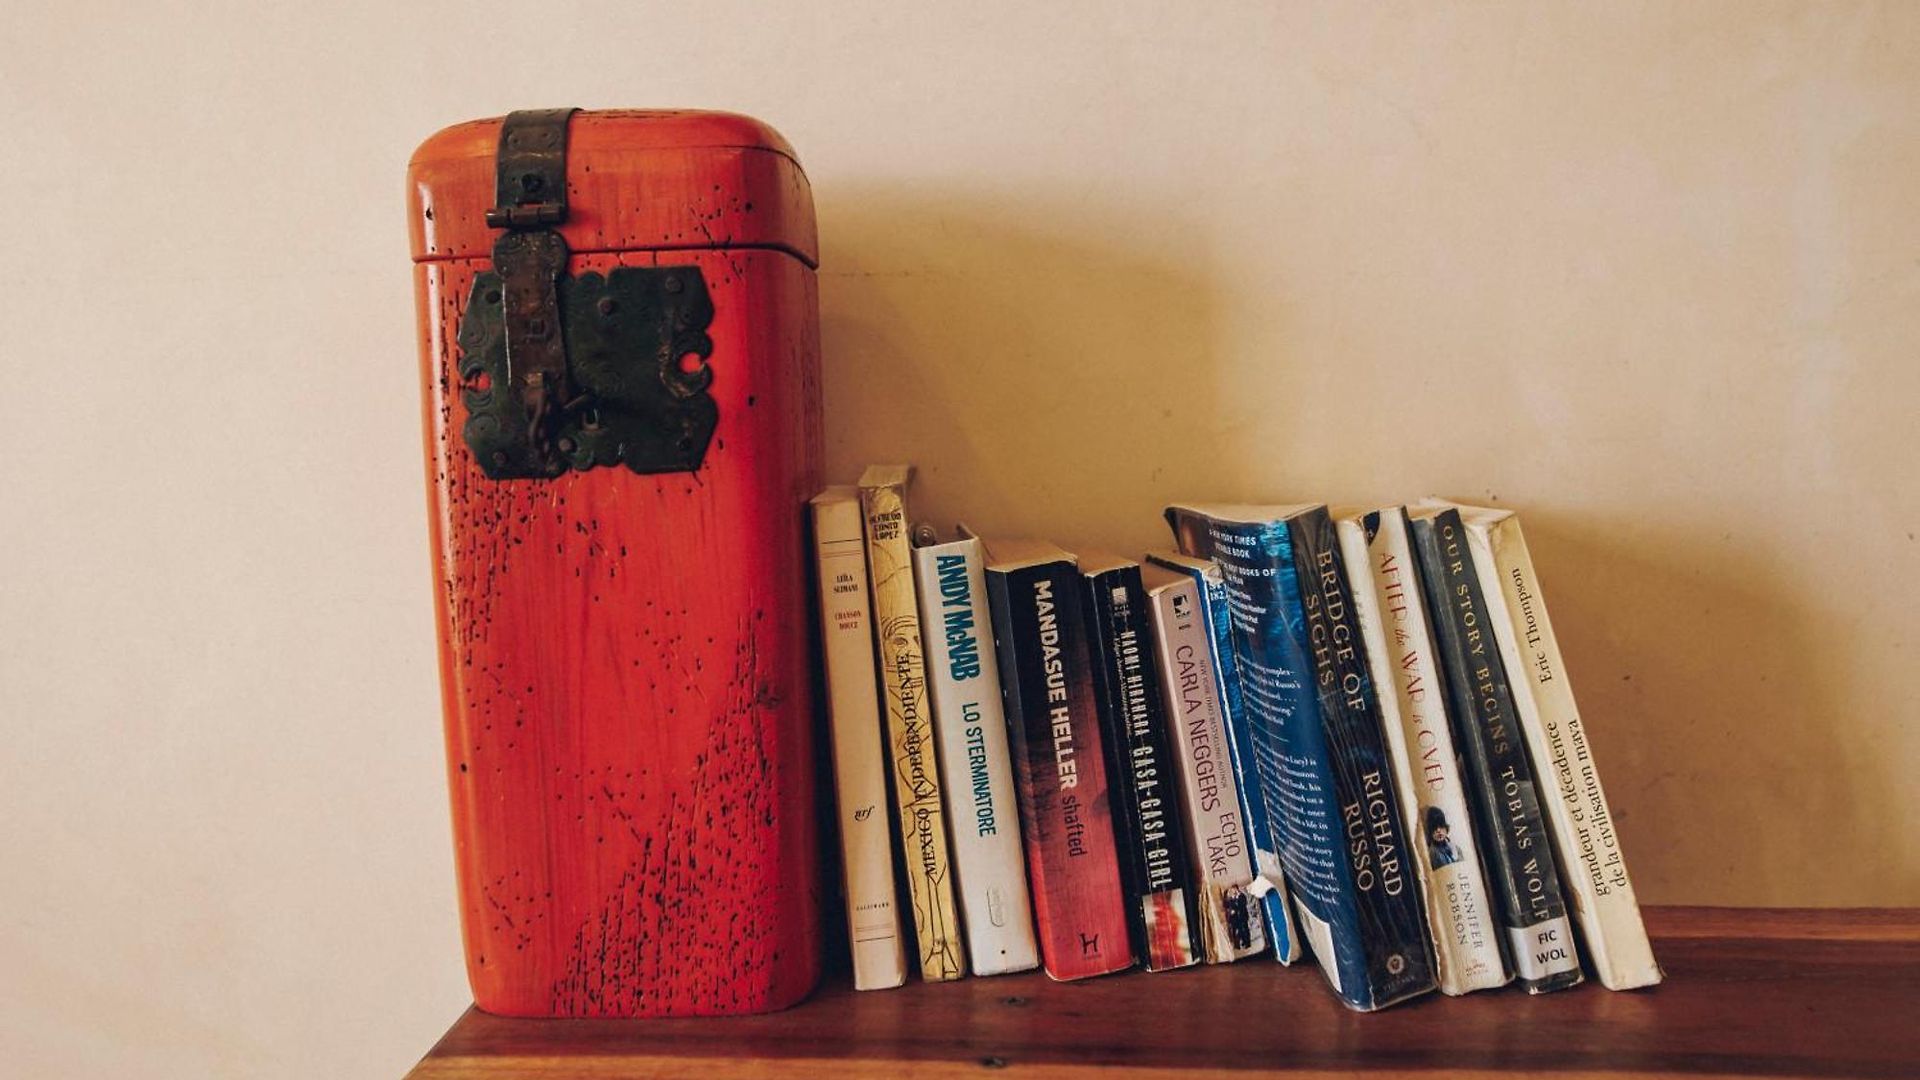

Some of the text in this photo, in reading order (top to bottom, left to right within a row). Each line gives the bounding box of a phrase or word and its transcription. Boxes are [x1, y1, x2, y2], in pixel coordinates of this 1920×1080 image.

[1234, 535, 1257, 546] TIMES
[1262, 568, 1277, 577] OF
[936, 555, 980, 681] ANDY McNAB
[1121, 631, 1141, 670] NAOMI
[1306, 595, 1335, 686] SIGHS
[1317, 551, 1365, 711] BRIDGE OF
[1444, 525, 1508, 756] OUR STORY BEGINS
[1511, 568, 1552, 684] Eric Thompson
[1034, 580, 1078, 791] MANDASUE HELLER
[1381, 552, 1408, 623] AFTER
[1402, 651, 1426, 704] WAR
[1418, 730, 1446, 791] OVER
[897, 653, 938, 875] MEXICO INDEPENDIENTE
[962, 702, 996, 837] LO STERMINATORE
[1176, 645, 1202, 714] CARLA
[1189, 720, 1221, 812] NEGGERS
[1062, 795, 1088, 858] shafted
[1133, 746, 1172, 888] GASA-GASA GIRL
[1220, 812, 1241, 857] ECHO
[1344, 801, 1374, 892] RUSSO
[1362, 770, 1402, 896] RICHARD
[1501, 765, 1532, 850] TOBIAS
[1547, 721, 1611, 897] grandeur et décadence
[1581, 765, 1616, 848] civilisation
[1207, 836, 1228, 877] LAKE
[1604, 852, 1619, 867] la
[1609, 868, 1627, 888] de
[1446, 883, 1468, 945] ROBSON
[1457, 872, 1484, 949] JENNIFER
[1538, 929, 1557, 945] FIC
[1536, 948, 1567, 965] WOL
